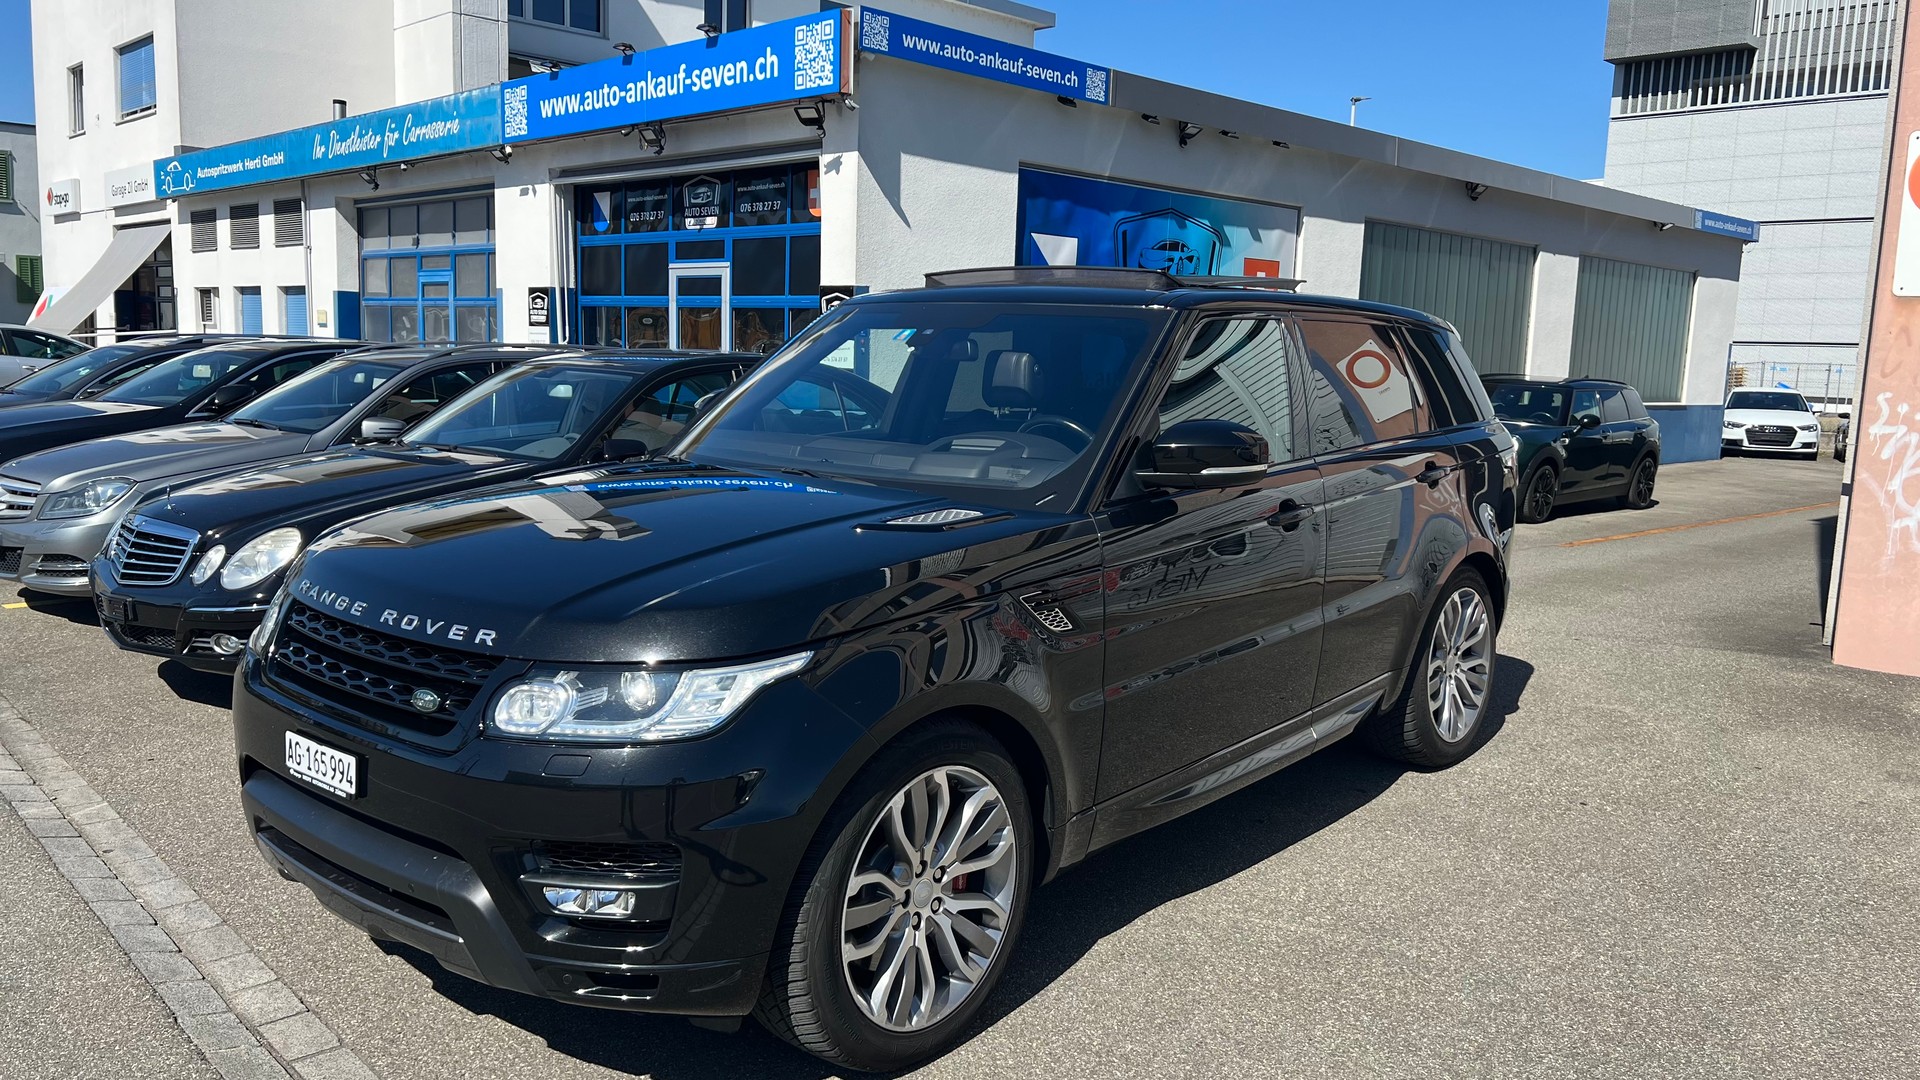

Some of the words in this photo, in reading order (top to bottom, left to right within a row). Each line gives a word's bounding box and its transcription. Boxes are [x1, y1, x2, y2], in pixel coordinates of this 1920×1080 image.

[902, 32, 1079, 88] www.auto-ankauf-seven.ch
[540, 47, 779, 119] www.auto-ankauf-seven.ch
[312, 133, 326, 160] Ihr
[328, 124, 381, 159] Dienstleister
[383, 118, 399, 158] für
[402, 111, 460, 146] Carrosserie
[197, 159, 243, 179] Autospritzwerk
[244, 155, 262, 171] Herti
[262, 151, 284, 168] GmbH
[111, 184, 127, 199] Garage
[134, 178, 149, 193] GmbH
[650, 211, 657, 220] 27
[658, 210, 664, 219] 37
[684, 207, 700, 217] AUTO
[701, 206, 719, 216] SEVEN
[740, 203, 751, 213] 076
[752, 202, 763, 212] 378
[764, 201, 772, 211] 27
[773, 200, 781, 210] 37
[298, 579, 368, 616] RANGE
[379, 609, 498, 647] ROVER
